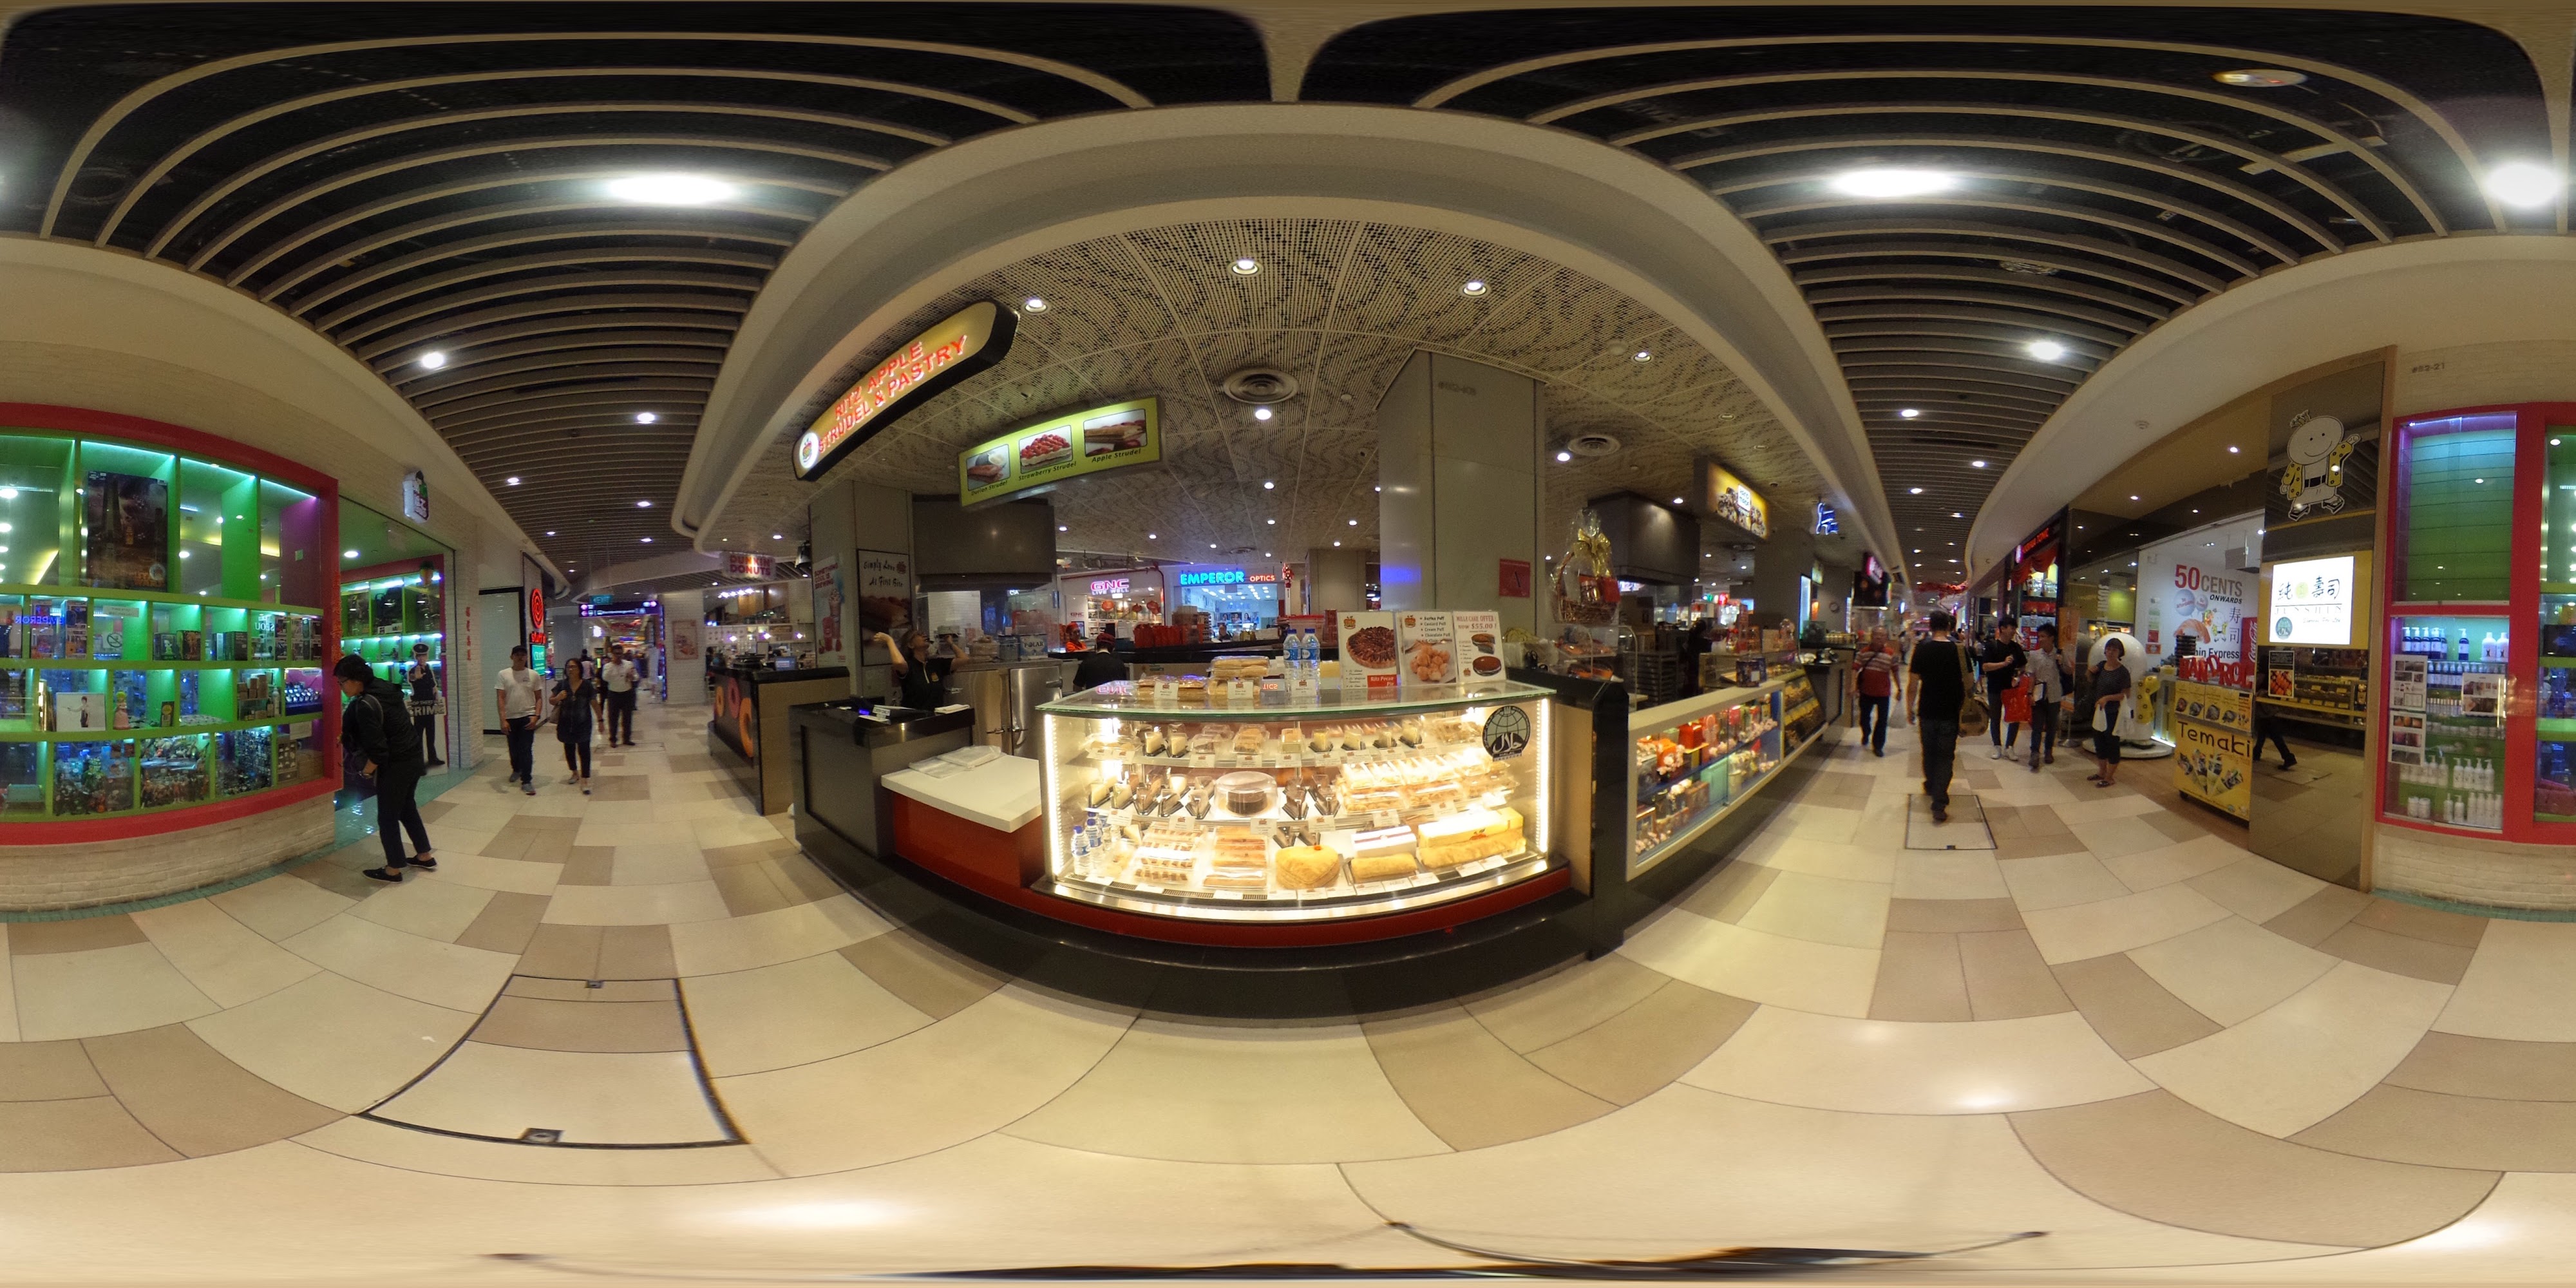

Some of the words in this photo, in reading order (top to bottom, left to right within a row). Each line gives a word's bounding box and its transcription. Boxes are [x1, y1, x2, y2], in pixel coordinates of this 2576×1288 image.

[835, 386, 862, 420] RITZ
[867, 341, 923, 394] APPLE
[819, 404, 873, 453] STRUDEL
[875, 390, 886, 408] &
[887, 334, 967, 398] PASTRY
[1092, 453, 1113, 463] Apple
[1114, 448, 1142, 459] Strudel
[1018, 469, 1052, 481] Strawberry
[1053, 460, 1077, 471] Strudel
[989, 480, 1007, 489] Strudel
[730, 564, 771, 576] DONUTS
[864, 558, 881, 571] Simply
[883, 560, 895, 571] Love
[1091, 579, 1129, 591] GNC
[1180, 571, 1244, 585] EMPEROR
[2175, 564, 2200, 591] 50
[2201, 574, 2243, 597] CENTS
[2210, 594, 2242, 604] ONWARDS
[2229, 607, 2241, 644] 寿司
[2209, 648, 2240, 659] Express
[407, 705, 445, 716] CRIME
[2177, 721, 2251, 757] Temaki
